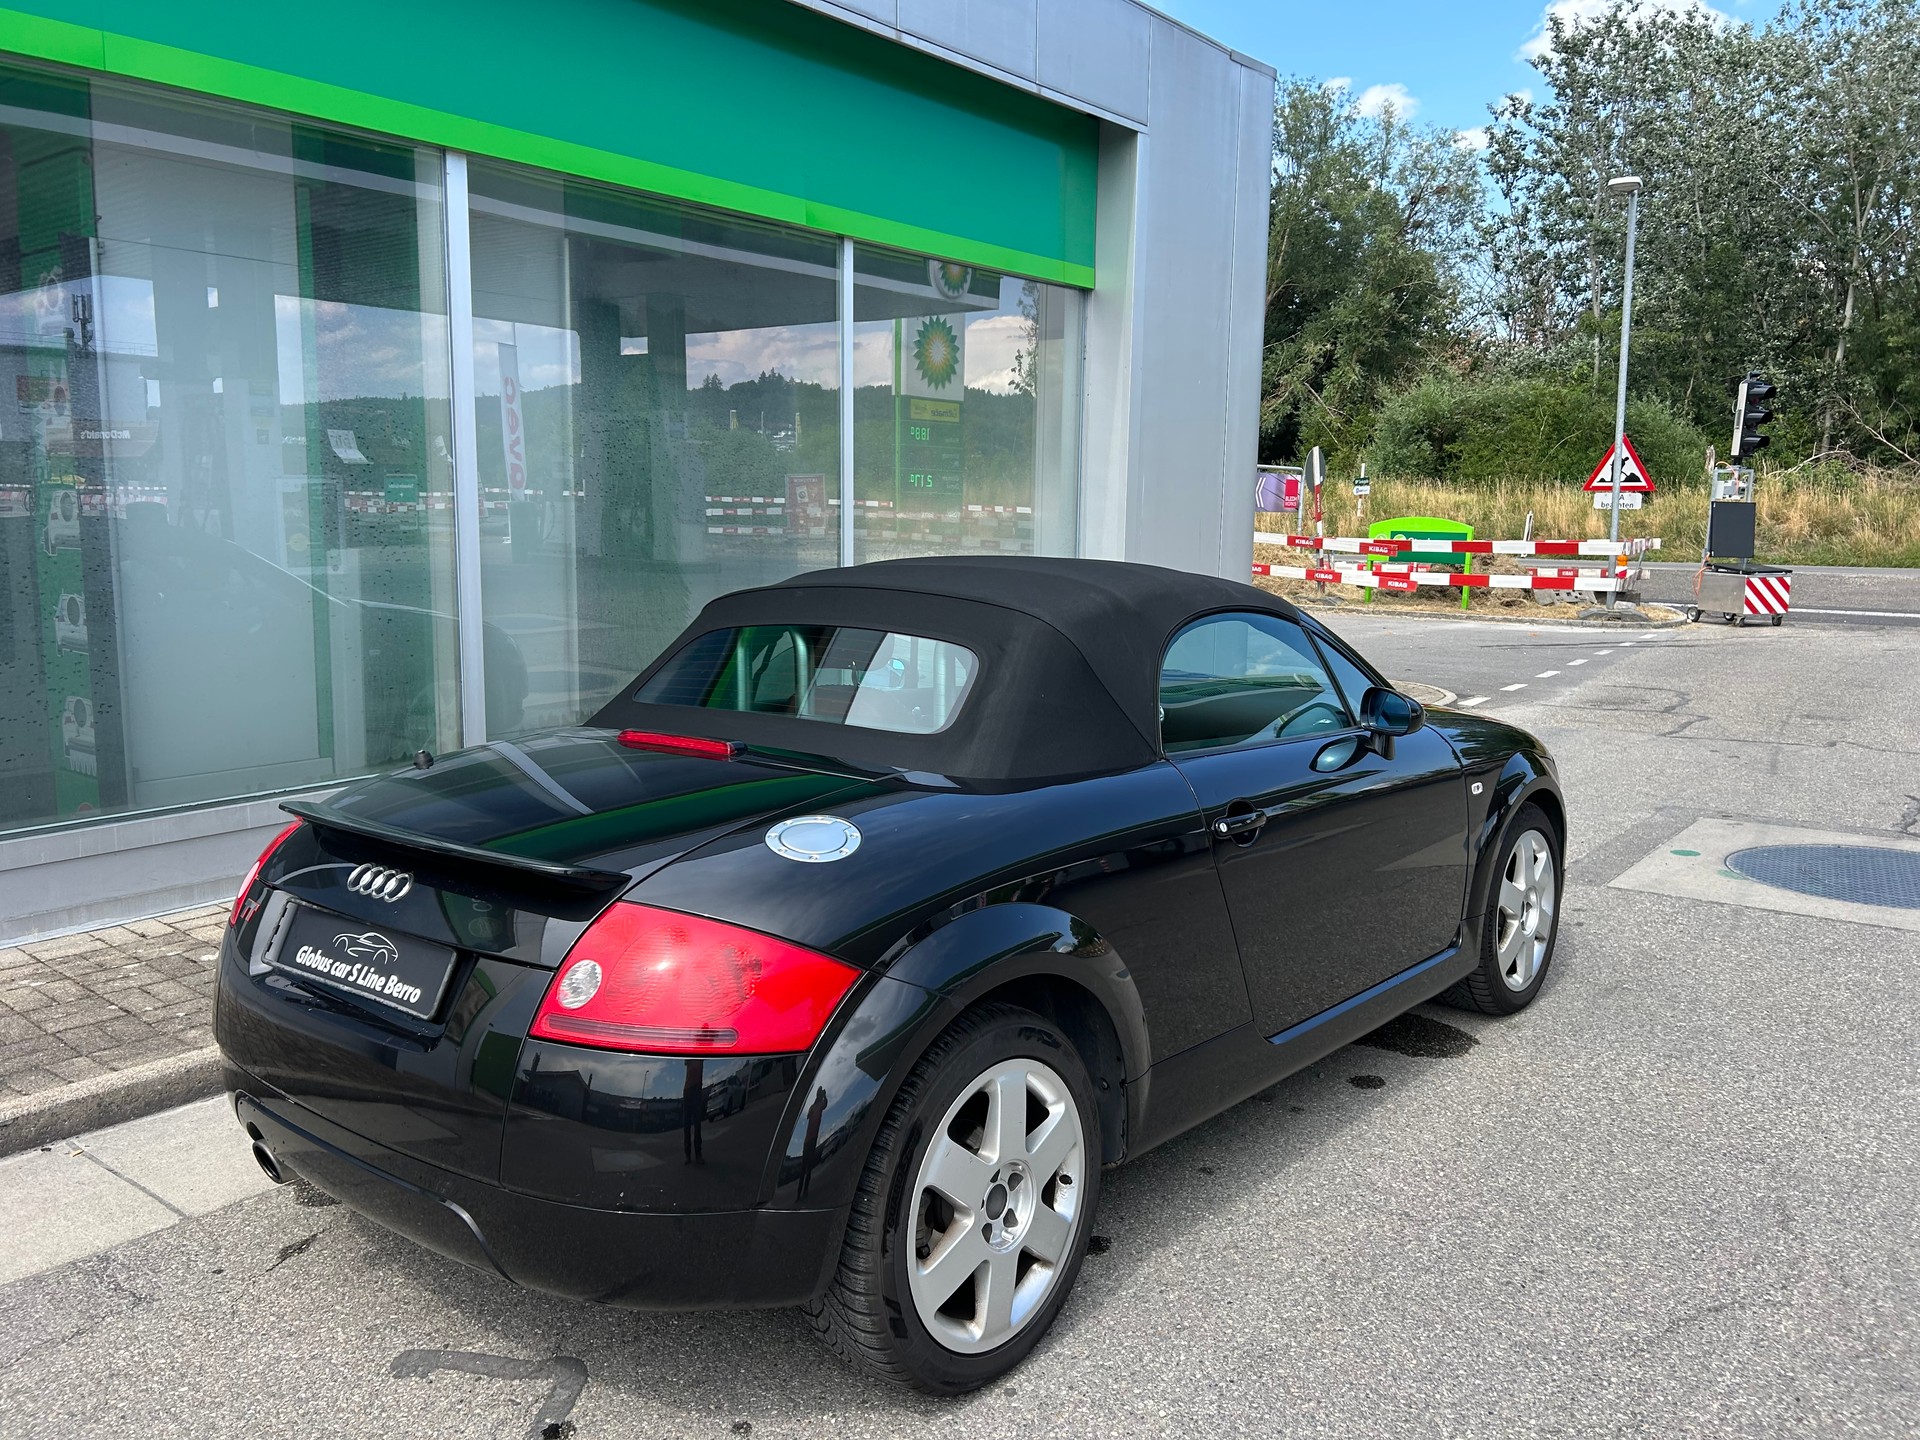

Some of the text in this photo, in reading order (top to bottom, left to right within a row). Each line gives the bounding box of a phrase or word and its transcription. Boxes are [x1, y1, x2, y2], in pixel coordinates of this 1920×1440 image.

[1368, 545, 1388, 553] KIBAG
[1315, 572, 1333, 580] KIBAG
[1387, 580, 1408, 588] KIBAG
[295, 945, 421, 1004] Globus car S Line Berro
